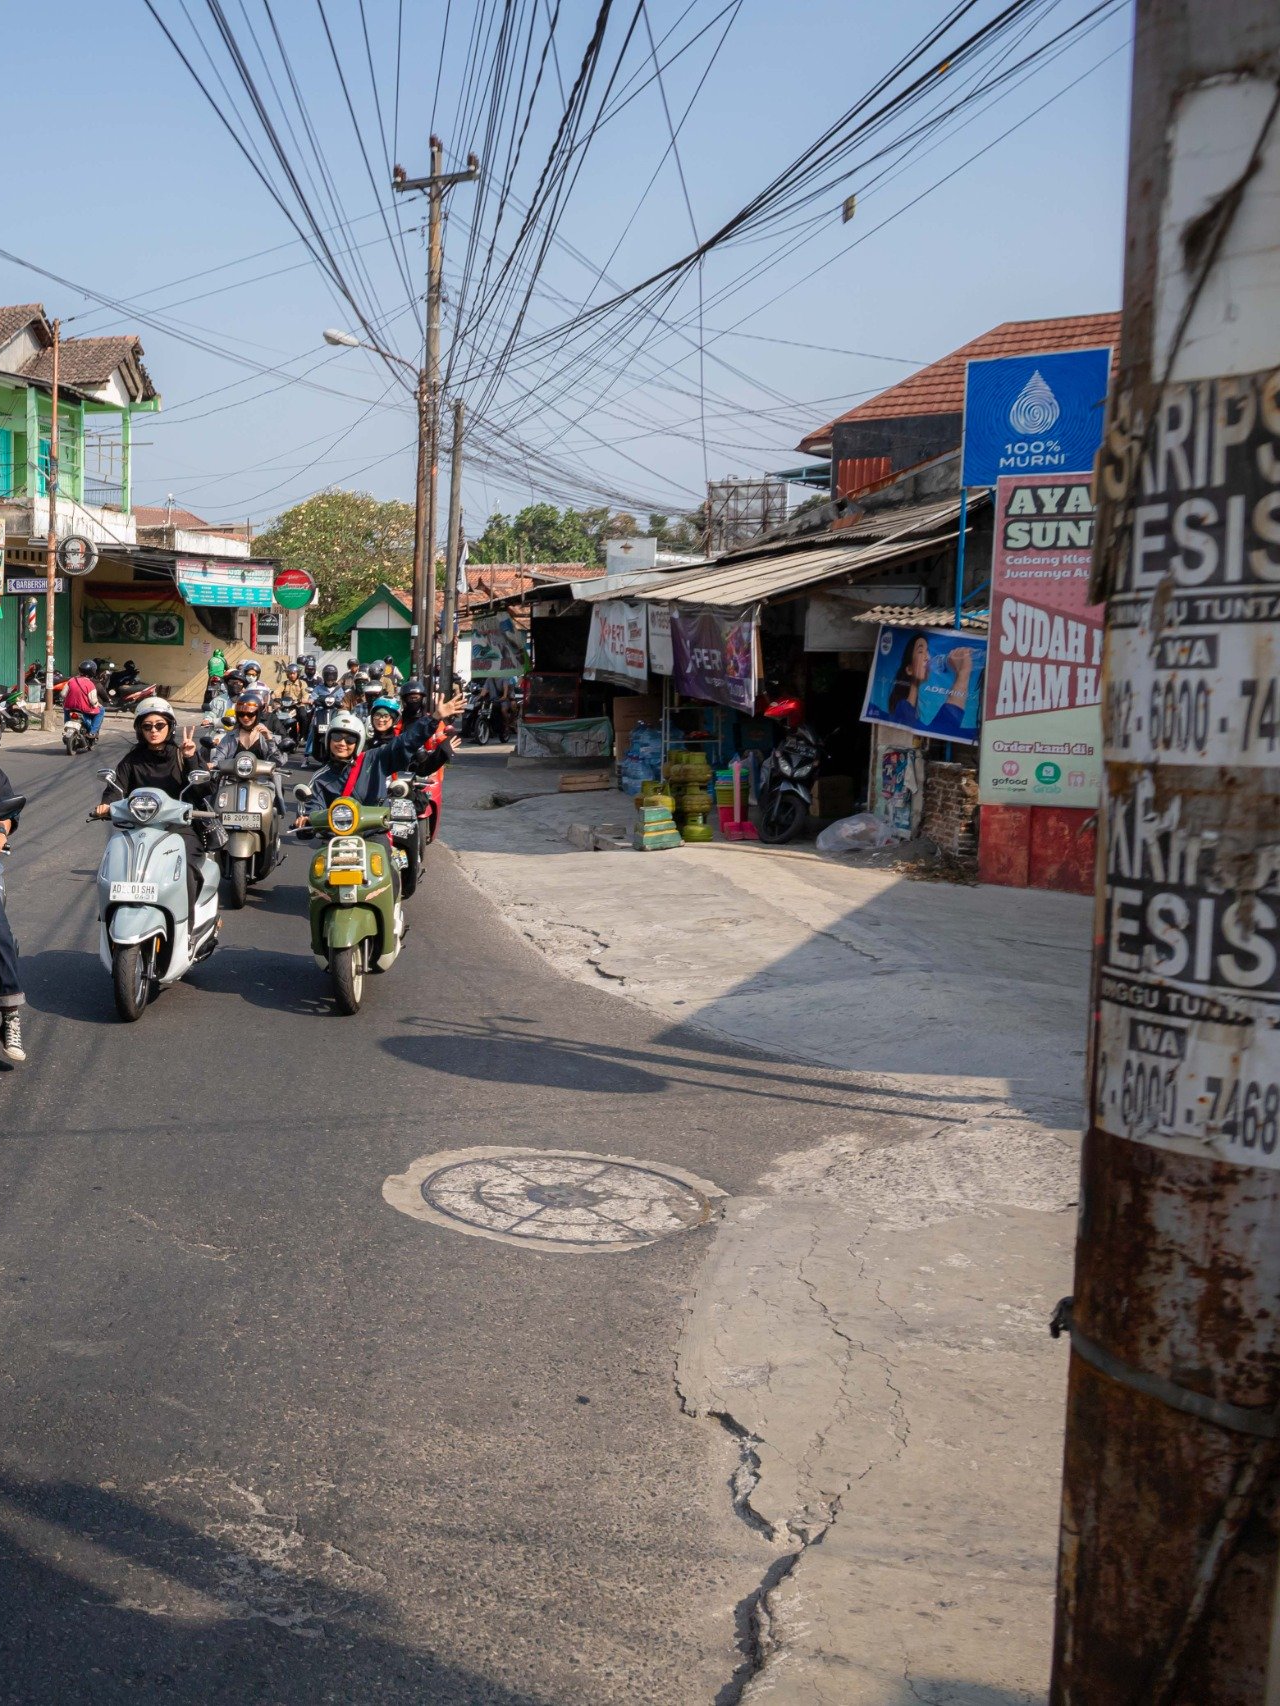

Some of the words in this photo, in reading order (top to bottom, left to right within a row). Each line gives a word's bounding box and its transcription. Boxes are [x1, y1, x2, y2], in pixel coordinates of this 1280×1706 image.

[999, 454, 1066, 468] MURNI
[1004, 440, 1061, 455] 100%
[1007, 486, 1096, 515] AYA
[1006, 520, 1095, 549] SUN
[1115, 490, 1280, 591] ESIS
[1004, 569, 1071, 580] Juaranya
[1005, 556, 1059, 567] Cabang
[16, 580, 49, 590] BARBERSH
[1000, 597, 1087, 664] SUDAH
[1164, 639, 1211, 666] WA
[995, 660, 1071, 716] AYAM
[993, 740, 1033, 753] Order
[1033, 742, 1070, 754] kami
[1071, 743, 1087, 755] di
[992, 777, 1028, 786] gofood
[1106, 885, 1277, 987] ESIS
[1136, 1024, 1179, 1056] WA
